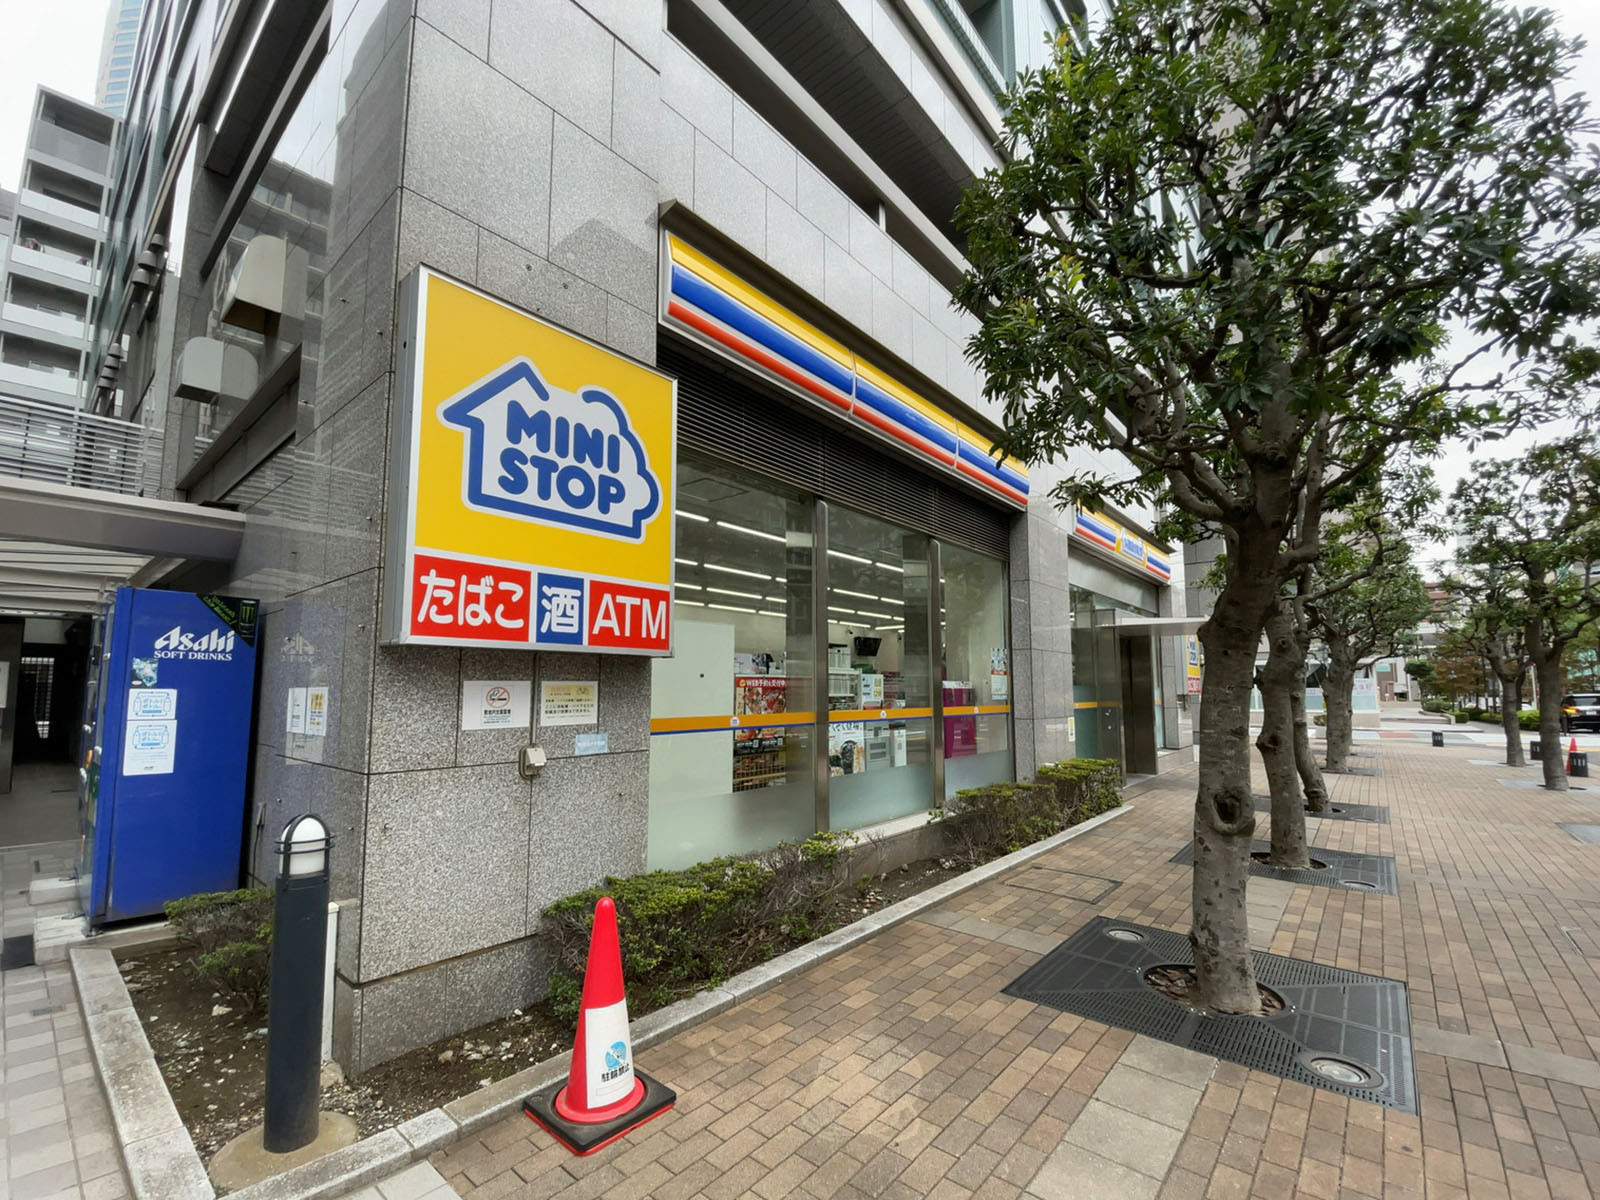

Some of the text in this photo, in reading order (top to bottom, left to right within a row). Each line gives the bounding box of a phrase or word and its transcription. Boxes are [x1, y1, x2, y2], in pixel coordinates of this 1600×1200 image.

[506, 399, 620, 474] MINI
[498, 447, 626, 515] STOP
[417, 568, 524, 628] たばこ
[541, 585, 582, 634] 酒
[592, 592, 667, 640] ATM
[153, 650, 233, 661] SOFT DRINKS
[154, 625, 235, 652] Asahi
